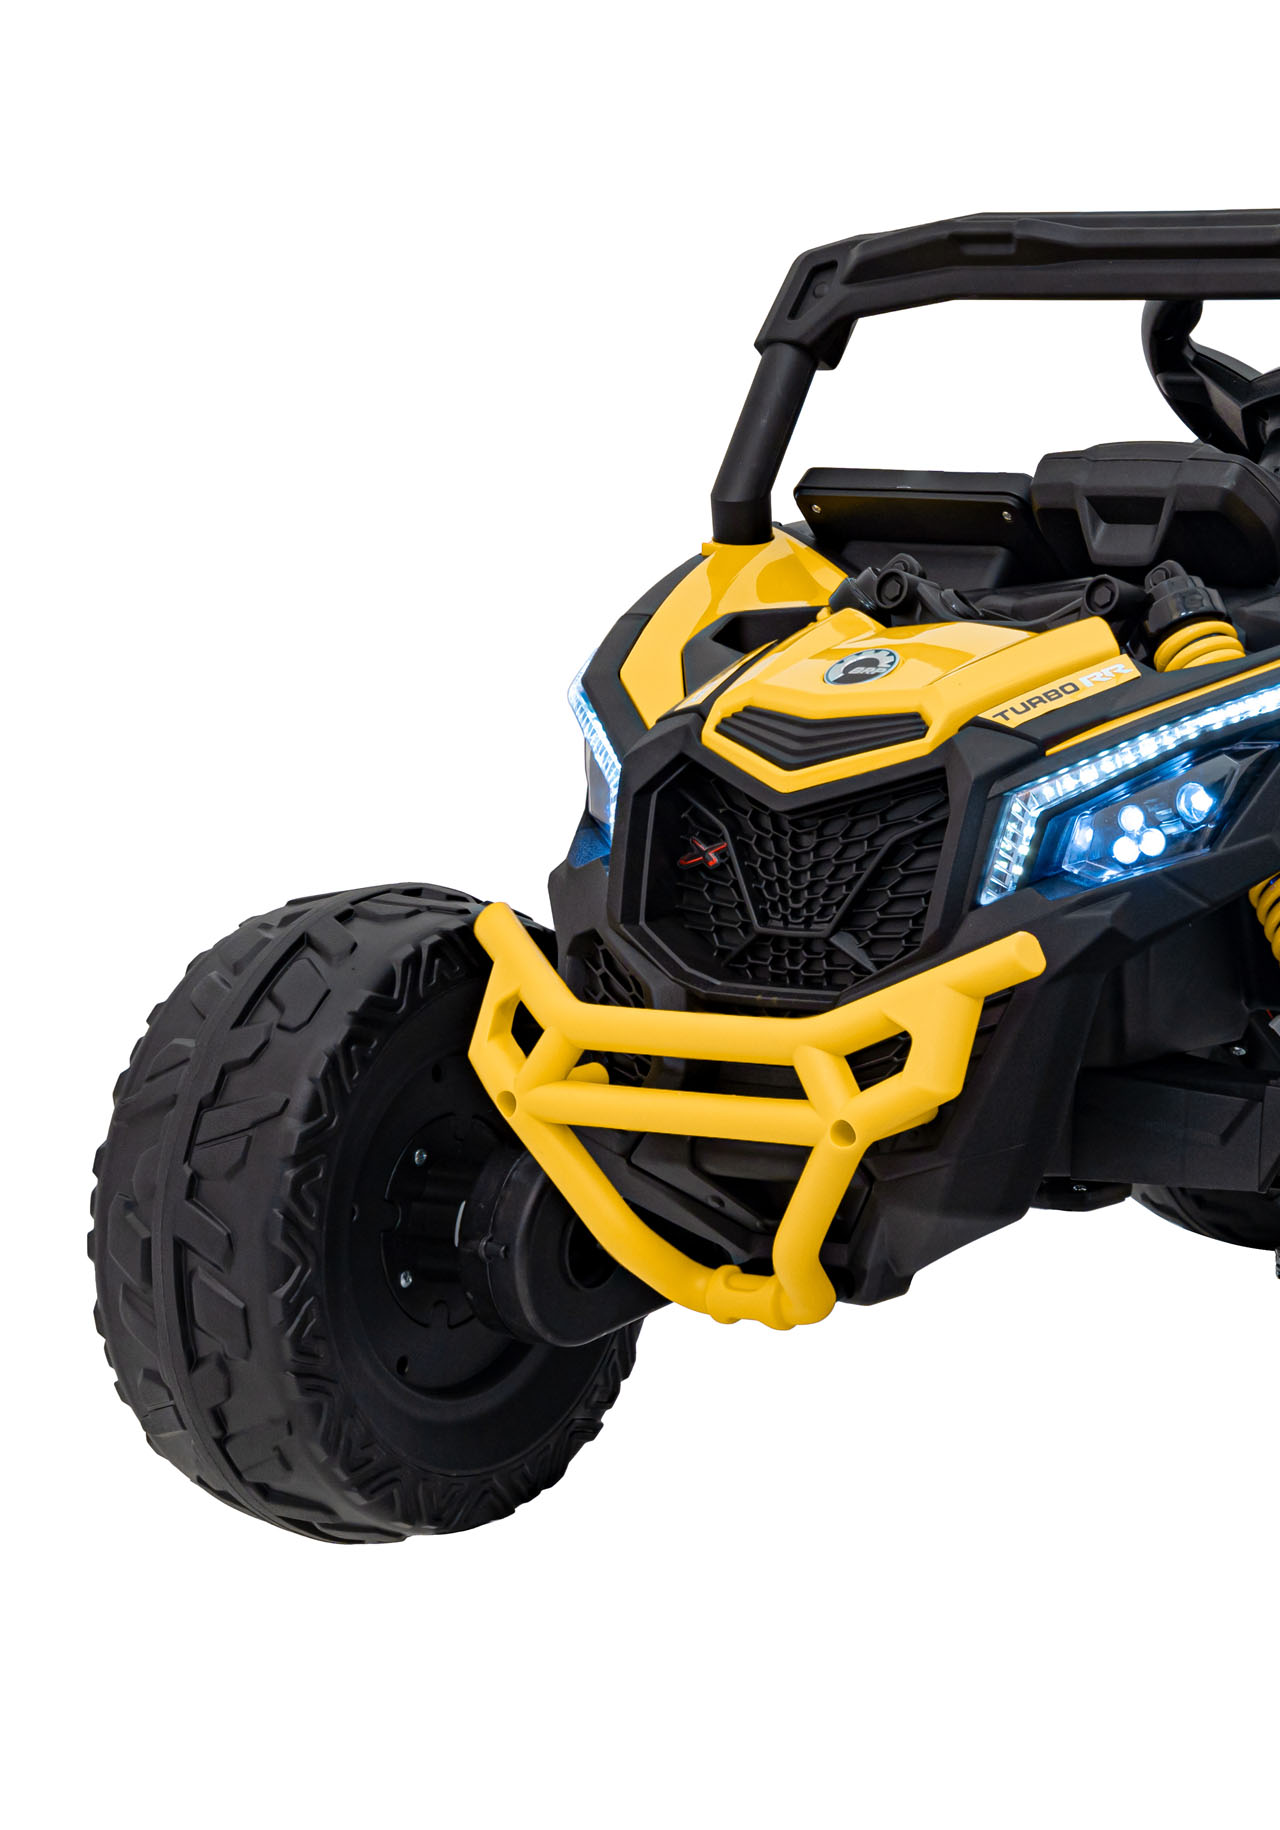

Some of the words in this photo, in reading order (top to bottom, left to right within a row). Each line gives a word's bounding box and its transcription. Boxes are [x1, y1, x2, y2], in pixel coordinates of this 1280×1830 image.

[848, 666, 888, 675] BRP
[991, 681, 1081, 722] TURBO
[1078, 663, 1133, 688] RR
